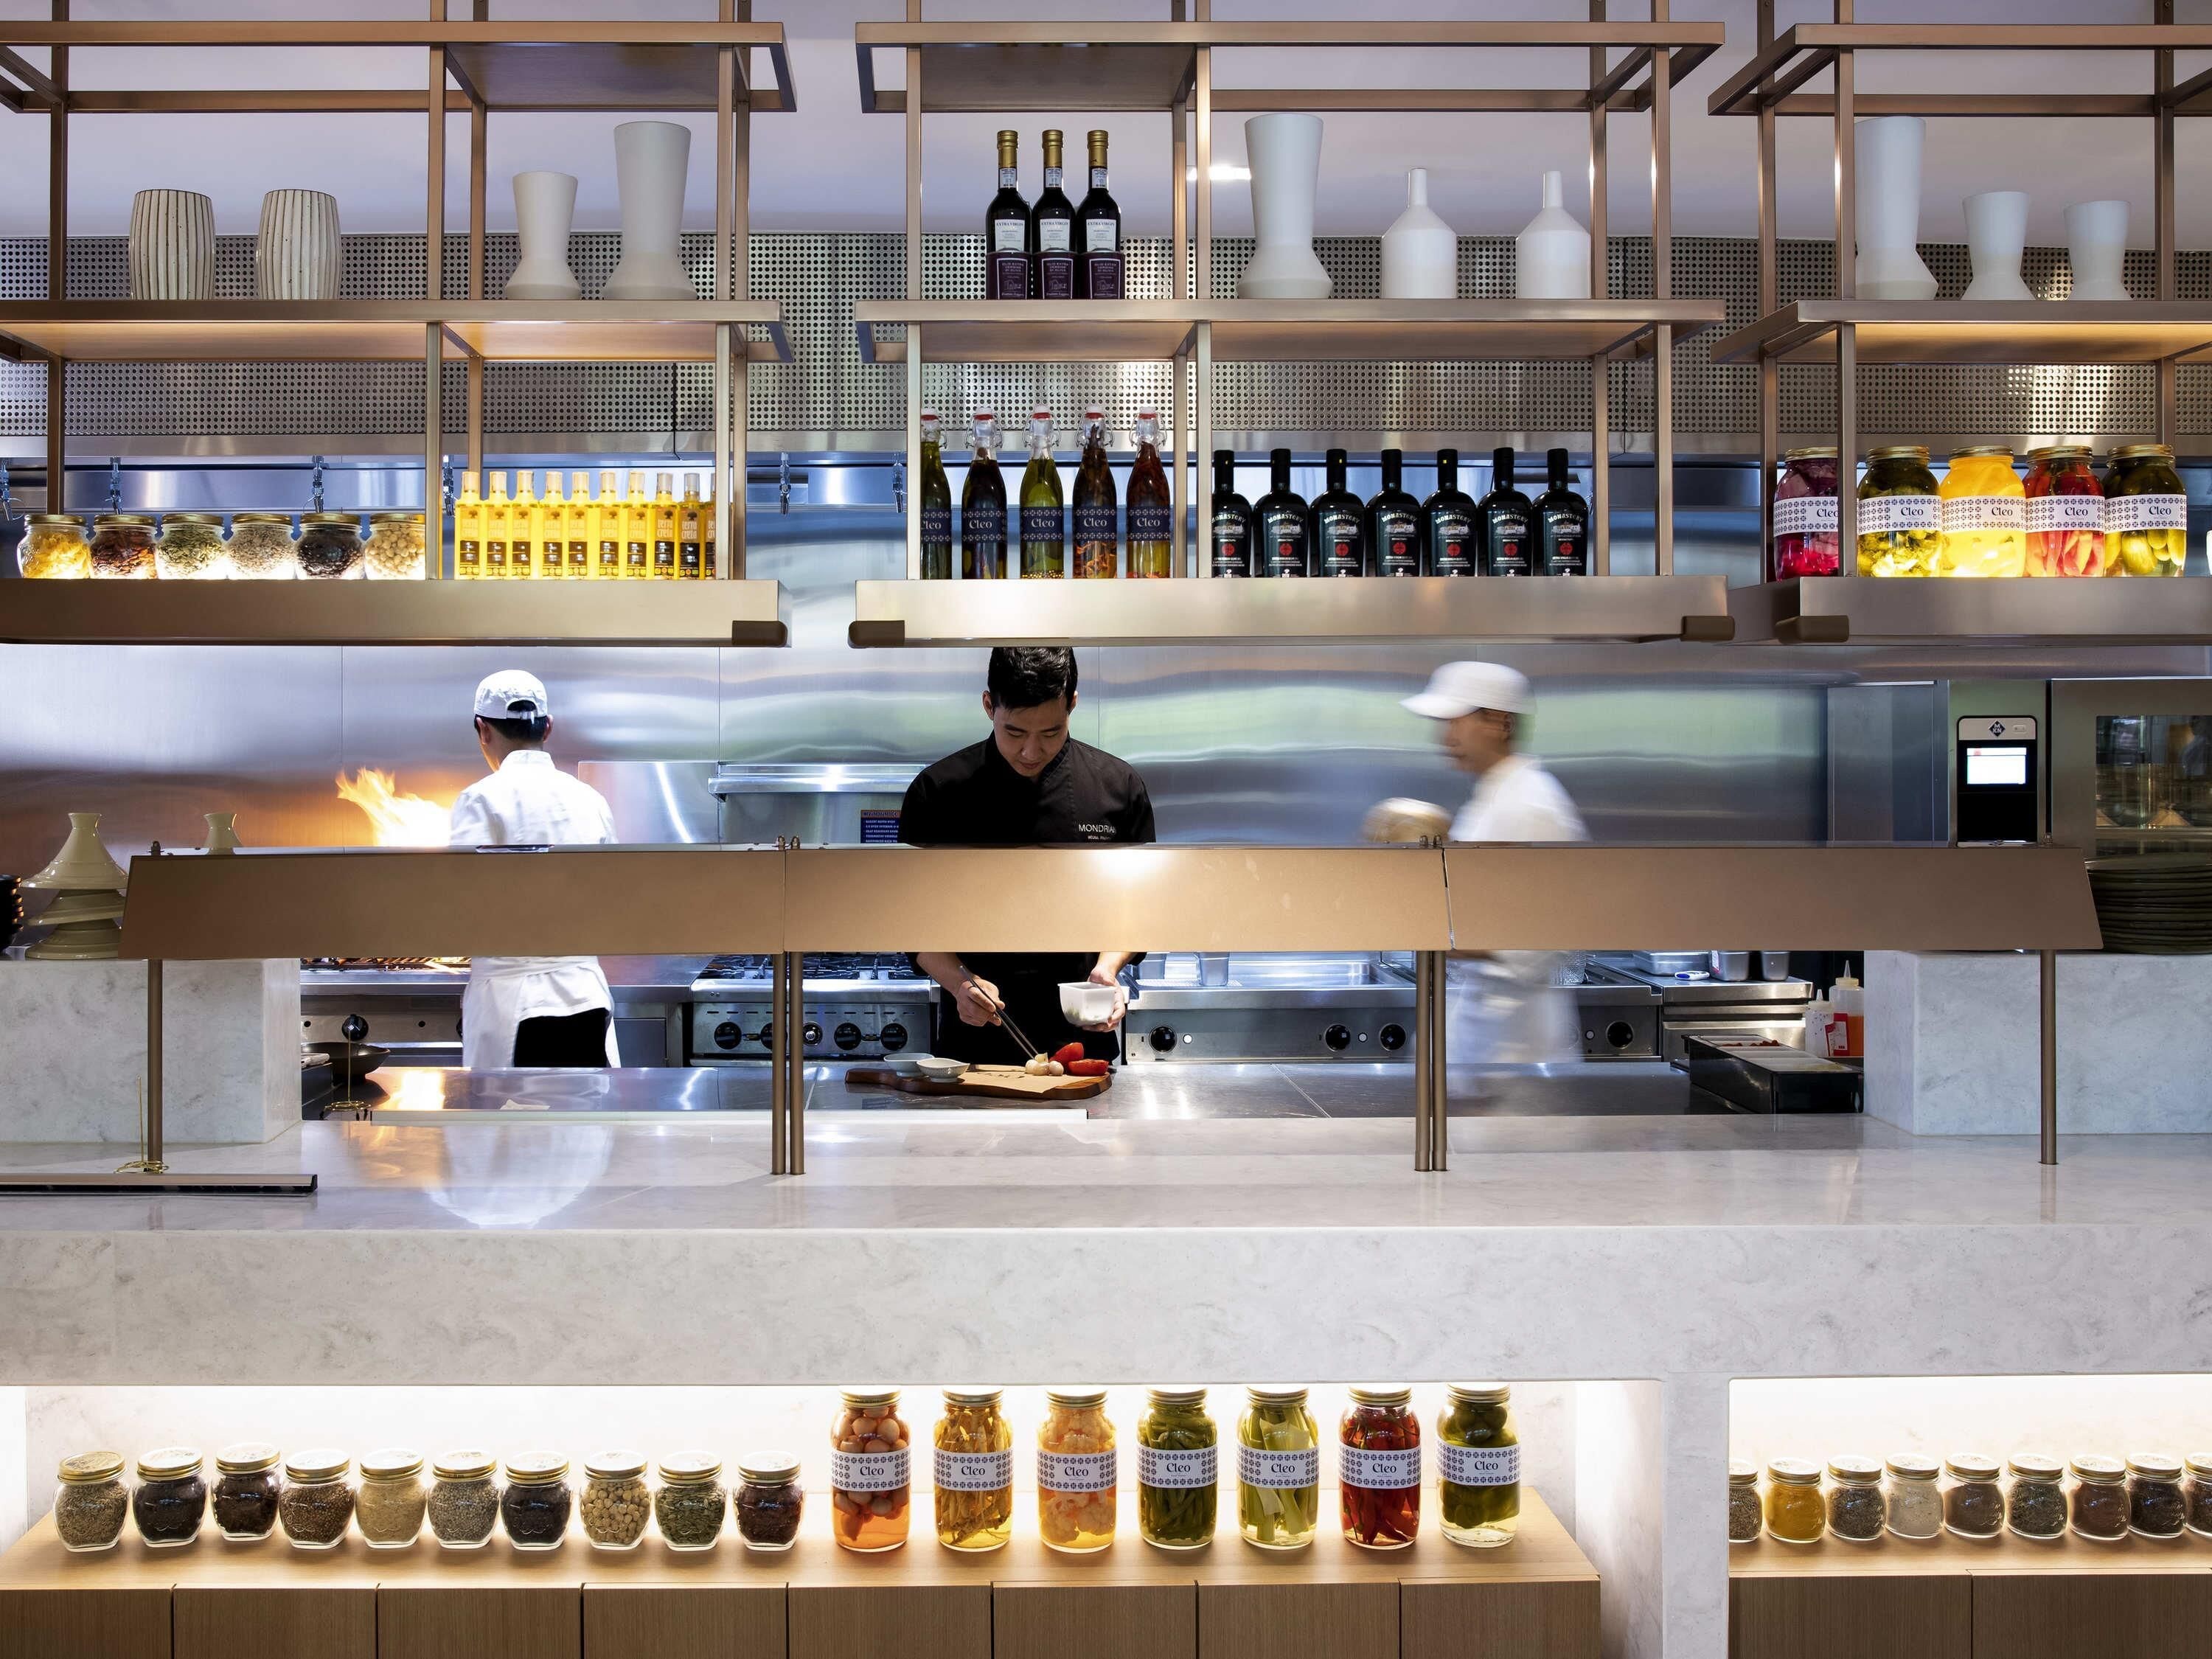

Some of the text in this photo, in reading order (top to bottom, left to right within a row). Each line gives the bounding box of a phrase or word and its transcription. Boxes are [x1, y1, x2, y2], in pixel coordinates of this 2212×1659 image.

[1900, 507, 1924, 516] Cleo
[1991, 507, 2013, 516] Cleo
[2065, 507, 2088, 516] Cleo
[2149, 506, 2171, 515] Cleo
[969, 518, 992, 529] Cleo
[1031, 518, 1055, 528] Cleo
[1083, 518, 1107, 527] Cleo
[1136, 518, 1161, 527] Cleo
[961, 1465, 985, 1475] Cleo
[1166, 1462, 1191, 1472] Cleo
[1270, 1463, 1295, 1473] Cleo
[1372, 1463, 1397, 1473] Cleo
[1475, 1460, 1498, 1470] Cleo
[860, 1466, 884, 1475] Cleo
[1064, 1466, 1089, 1476] Cleo
